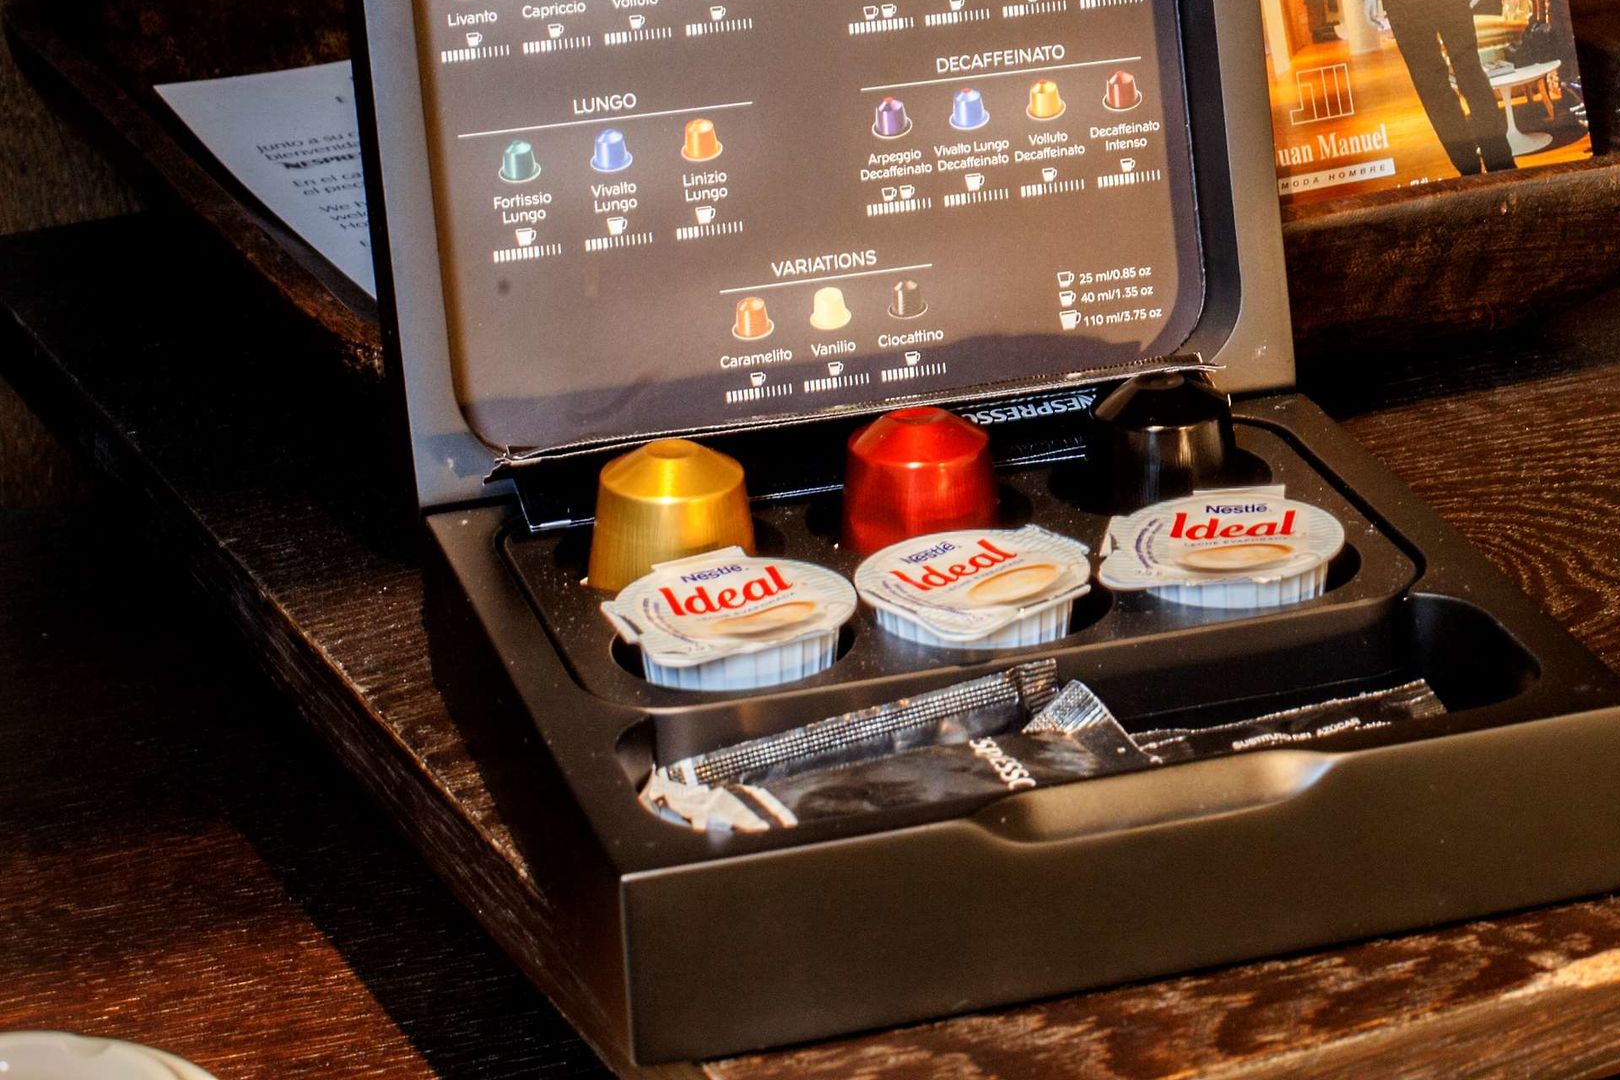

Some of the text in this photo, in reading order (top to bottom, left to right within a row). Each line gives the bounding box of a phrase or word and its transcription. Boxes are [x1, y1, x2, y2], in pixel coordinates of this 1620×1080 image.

[447, 9, 498, 26] Livanto
[522, 1, 586, 20] Capriccio
[936, 44, 1065, 73] DECAFFEINATO
[573, 93, 637, 115] LUNGO
[1028, 131, 1068, 146] Volluto
[1089, 120, 1160, 139] Decaffeinato
[934, 138, 1009, 157] Vivalto Lungo
[1105, 136, 1148, 151] Intenso
[1277, 123, 1389, 167] uan Manuel
[868, 148, 922, 166] Arpeggio
[937, 153, 1009, 172] Decaffeinato
[1014, 144, 1085, 163] Decaffeinato
[682, 171, 727, 188] Linizio
[860, 162, 932, 181] Decaffeinato
[1281, 164, 1386, 190] MODA HOMBRE
[591, 182, 637, 199] Vivalto
[685, 186, 728, 203] Lungo
[493, 192, 552, 210] Fortissio
[594, 197, 638, 213] Lungo
[502, 208, 547, 225] Lungo
[771, 249, 877, 278] VARIATIONS
[1079, 273, 1093, 285] 25
[1138, 266, 1152, 276] oz
[1080, 292, 1095, 303] 40
[1141, 285, 1154, 296] oz
[1083, 314, 1104, 327] 110
[1149, 307, 1162, 318] oz
[878, 329, 944, 348] Ciocattino
[811, 340, 856, 357] Vanilio
[720, 349, 793, 369] Caramelito
[1205, 502, 1268, 514] Nestlé
[1169, 510, 1296, 540] Ideal
[890, 538, 1017, 591] Ideal
[659, 565, 793, 617] Ideal
